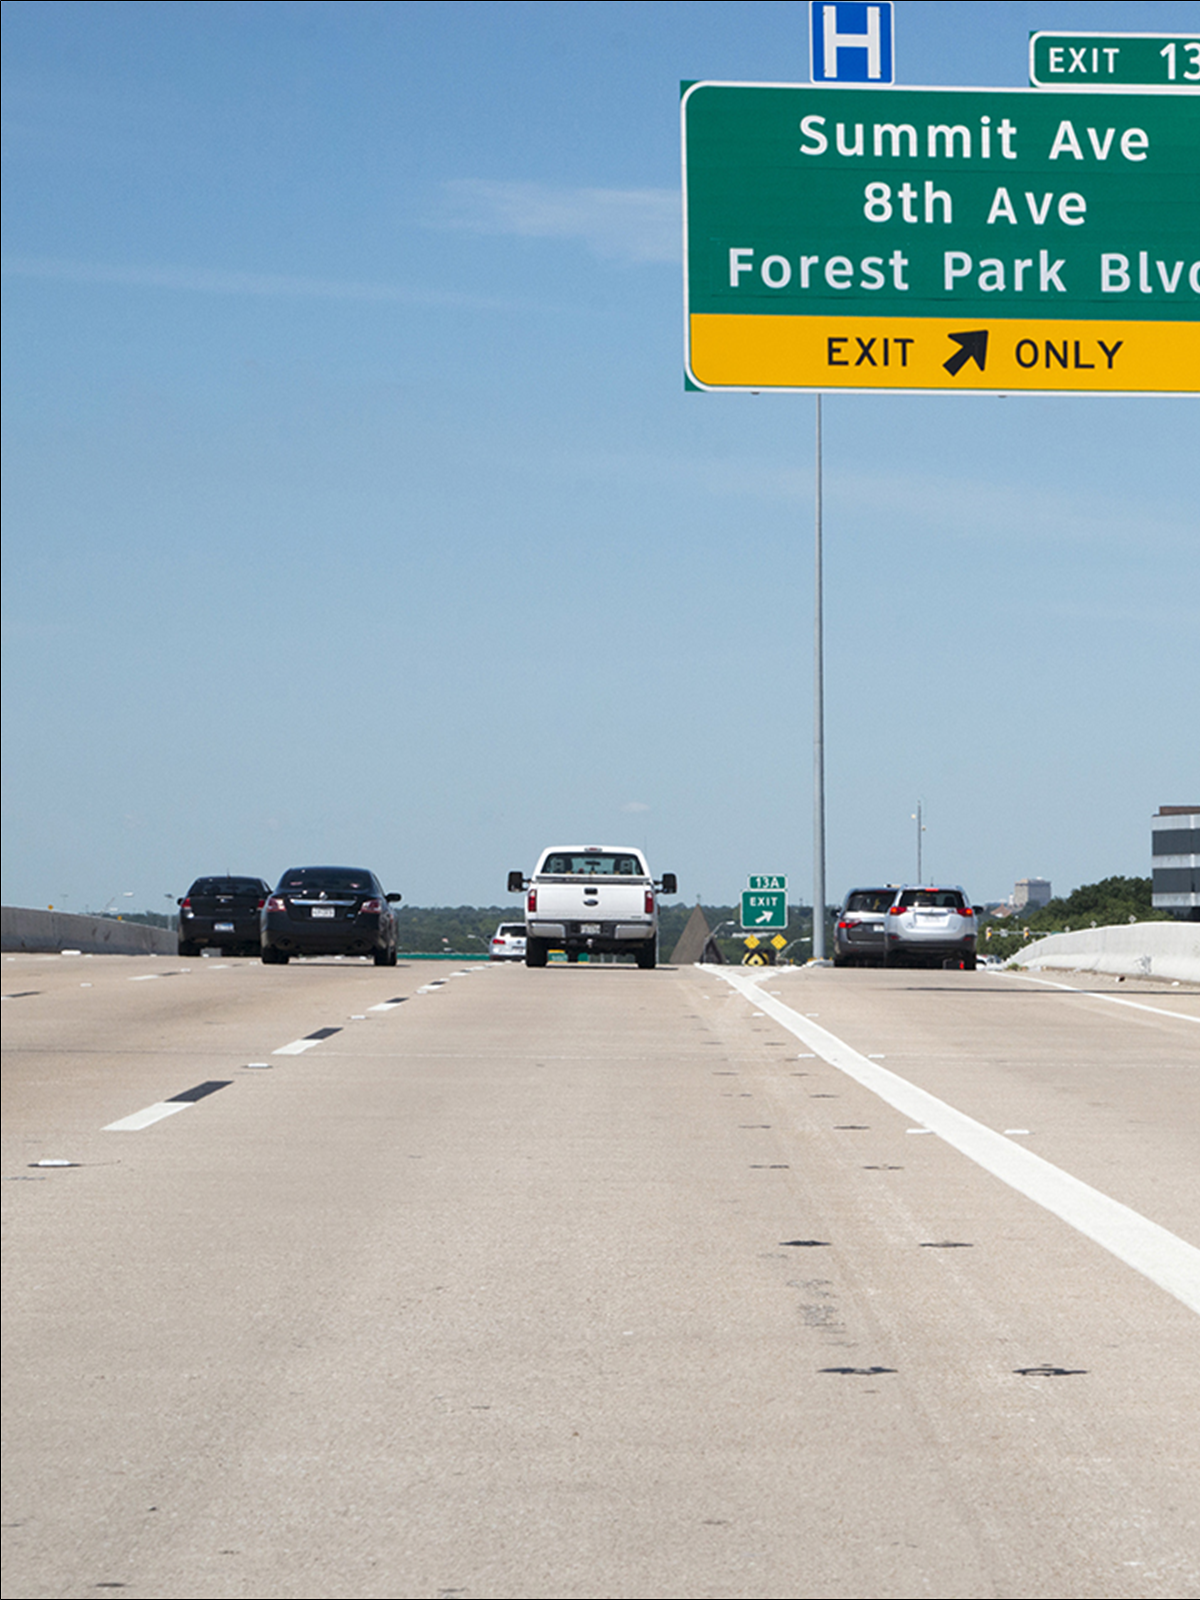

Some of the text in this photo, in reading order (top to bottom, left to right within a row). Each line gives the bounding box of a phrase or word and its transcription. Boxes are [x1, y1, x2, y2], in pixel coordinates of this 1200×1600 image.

[823, 5, 881, 79] H
[1049, 48, 1120, 73] EXIT
[799, 115, 1149, 161] Summit Ave
[863, 181, 1087, 225] 8th Ave
[729, 248, 909, 290] Forest
[944, 250, 1067, 292] Park
[827, 338, 1124, 369] EXIT ONLY
[756, 876, 780, 888] 13A
[749, 896, 778, 907] EXIT
